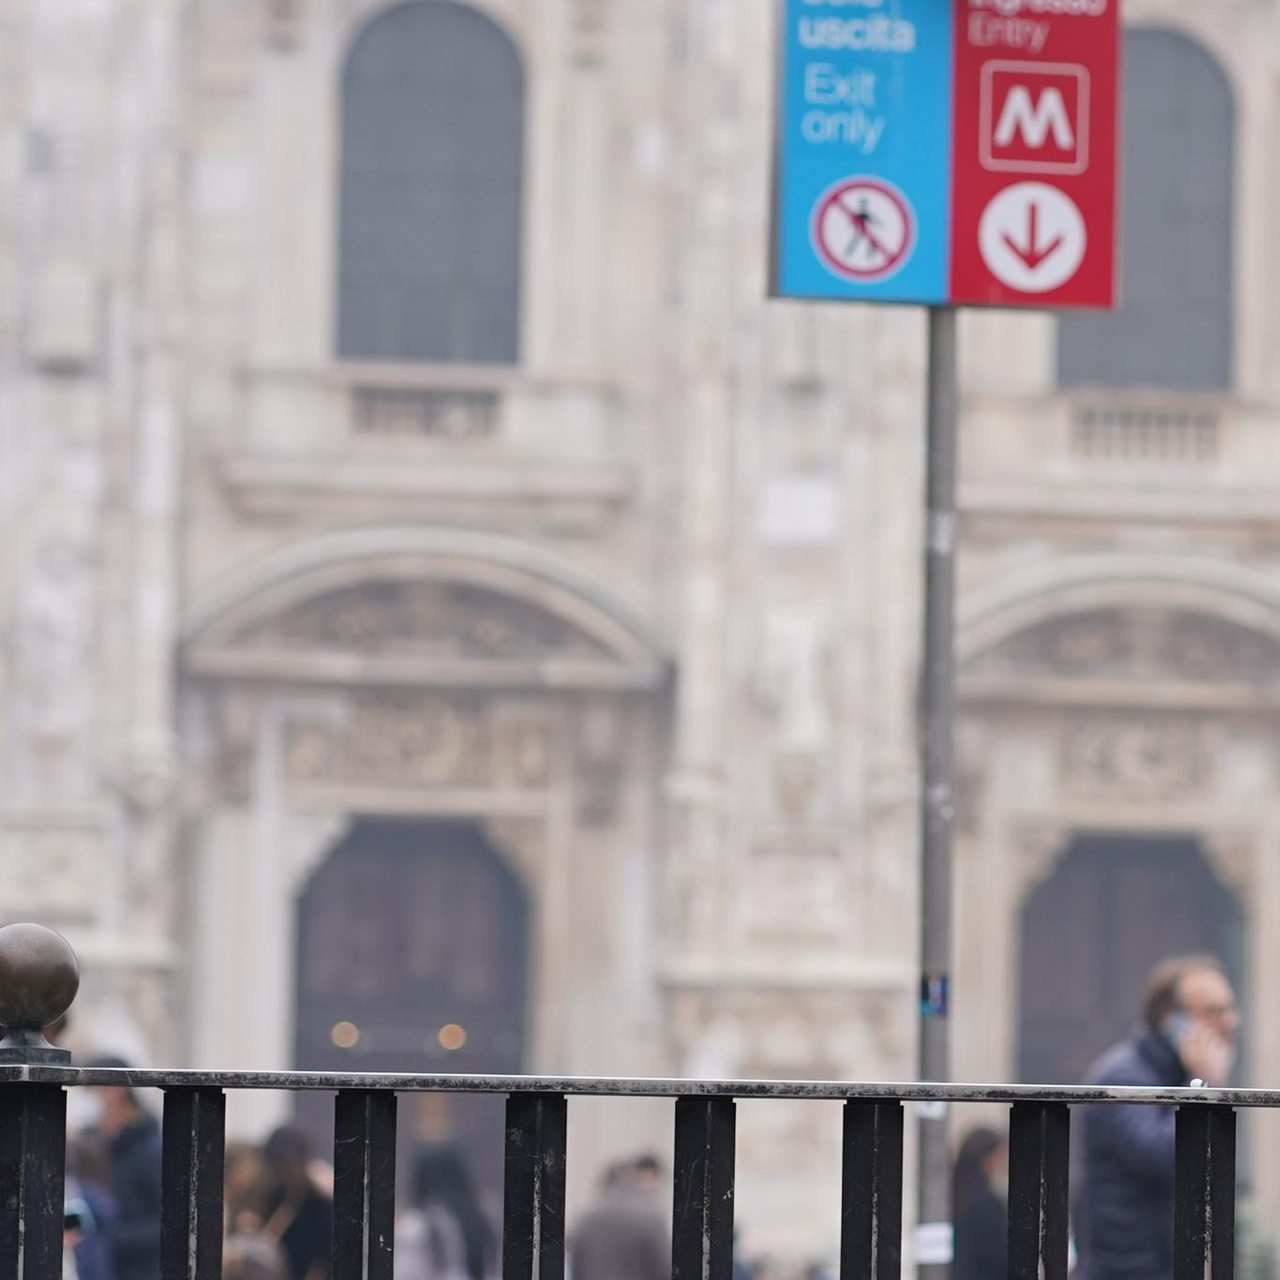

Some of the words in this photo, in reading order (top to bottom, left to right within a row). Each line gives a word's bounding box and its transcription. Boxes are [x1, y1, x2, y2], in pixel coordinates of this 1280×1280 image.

[798, 13, 915, 52] uscita
[967, 11, 1049, 54] Entry
[804, 63, 876, 106] Exit
[801, 109, 883, 155] only
[993, 85, 1075, 150] M
